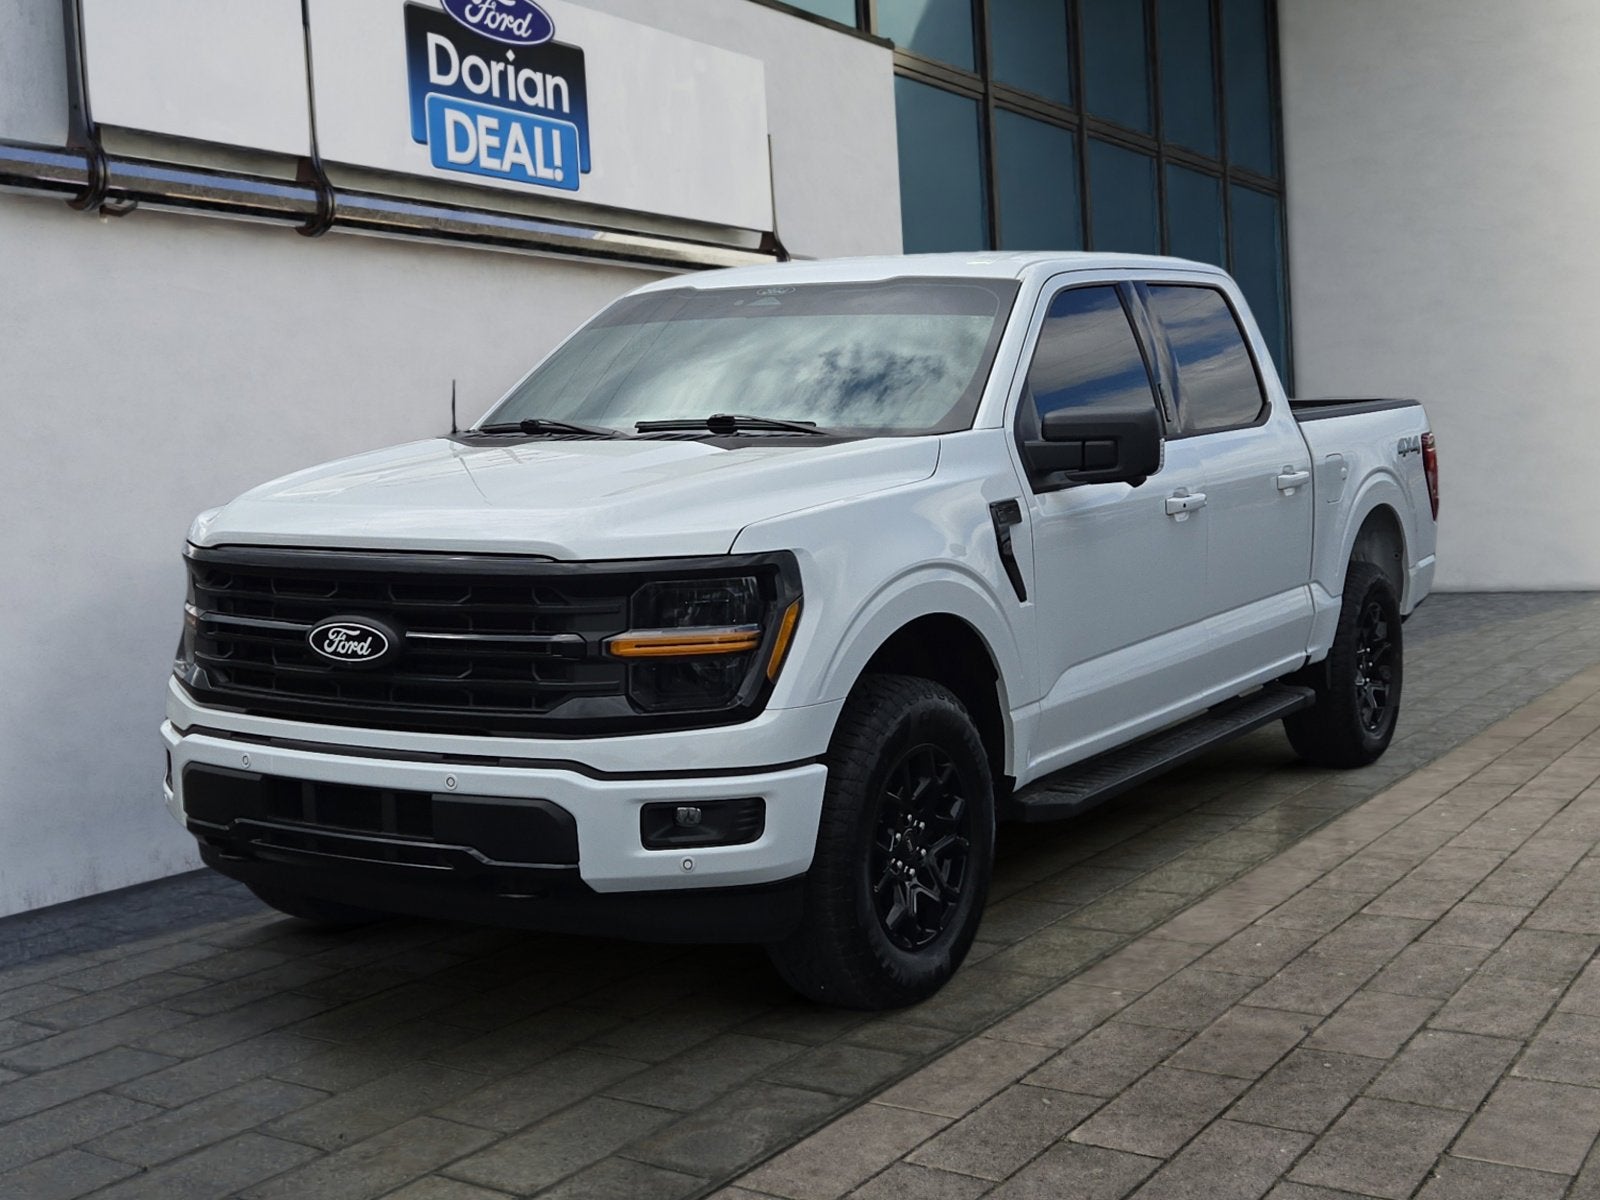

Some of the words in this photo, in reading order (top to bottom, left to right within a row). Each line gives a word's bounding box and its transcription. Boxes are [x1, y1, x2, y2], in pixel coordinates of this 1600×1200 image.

[464, 0, 533, 38] Ford
[426, 31, 571, 114] Dorian
[443, 107, 565, 183] DEAL!
[323, 627, 373, 656] Ford
